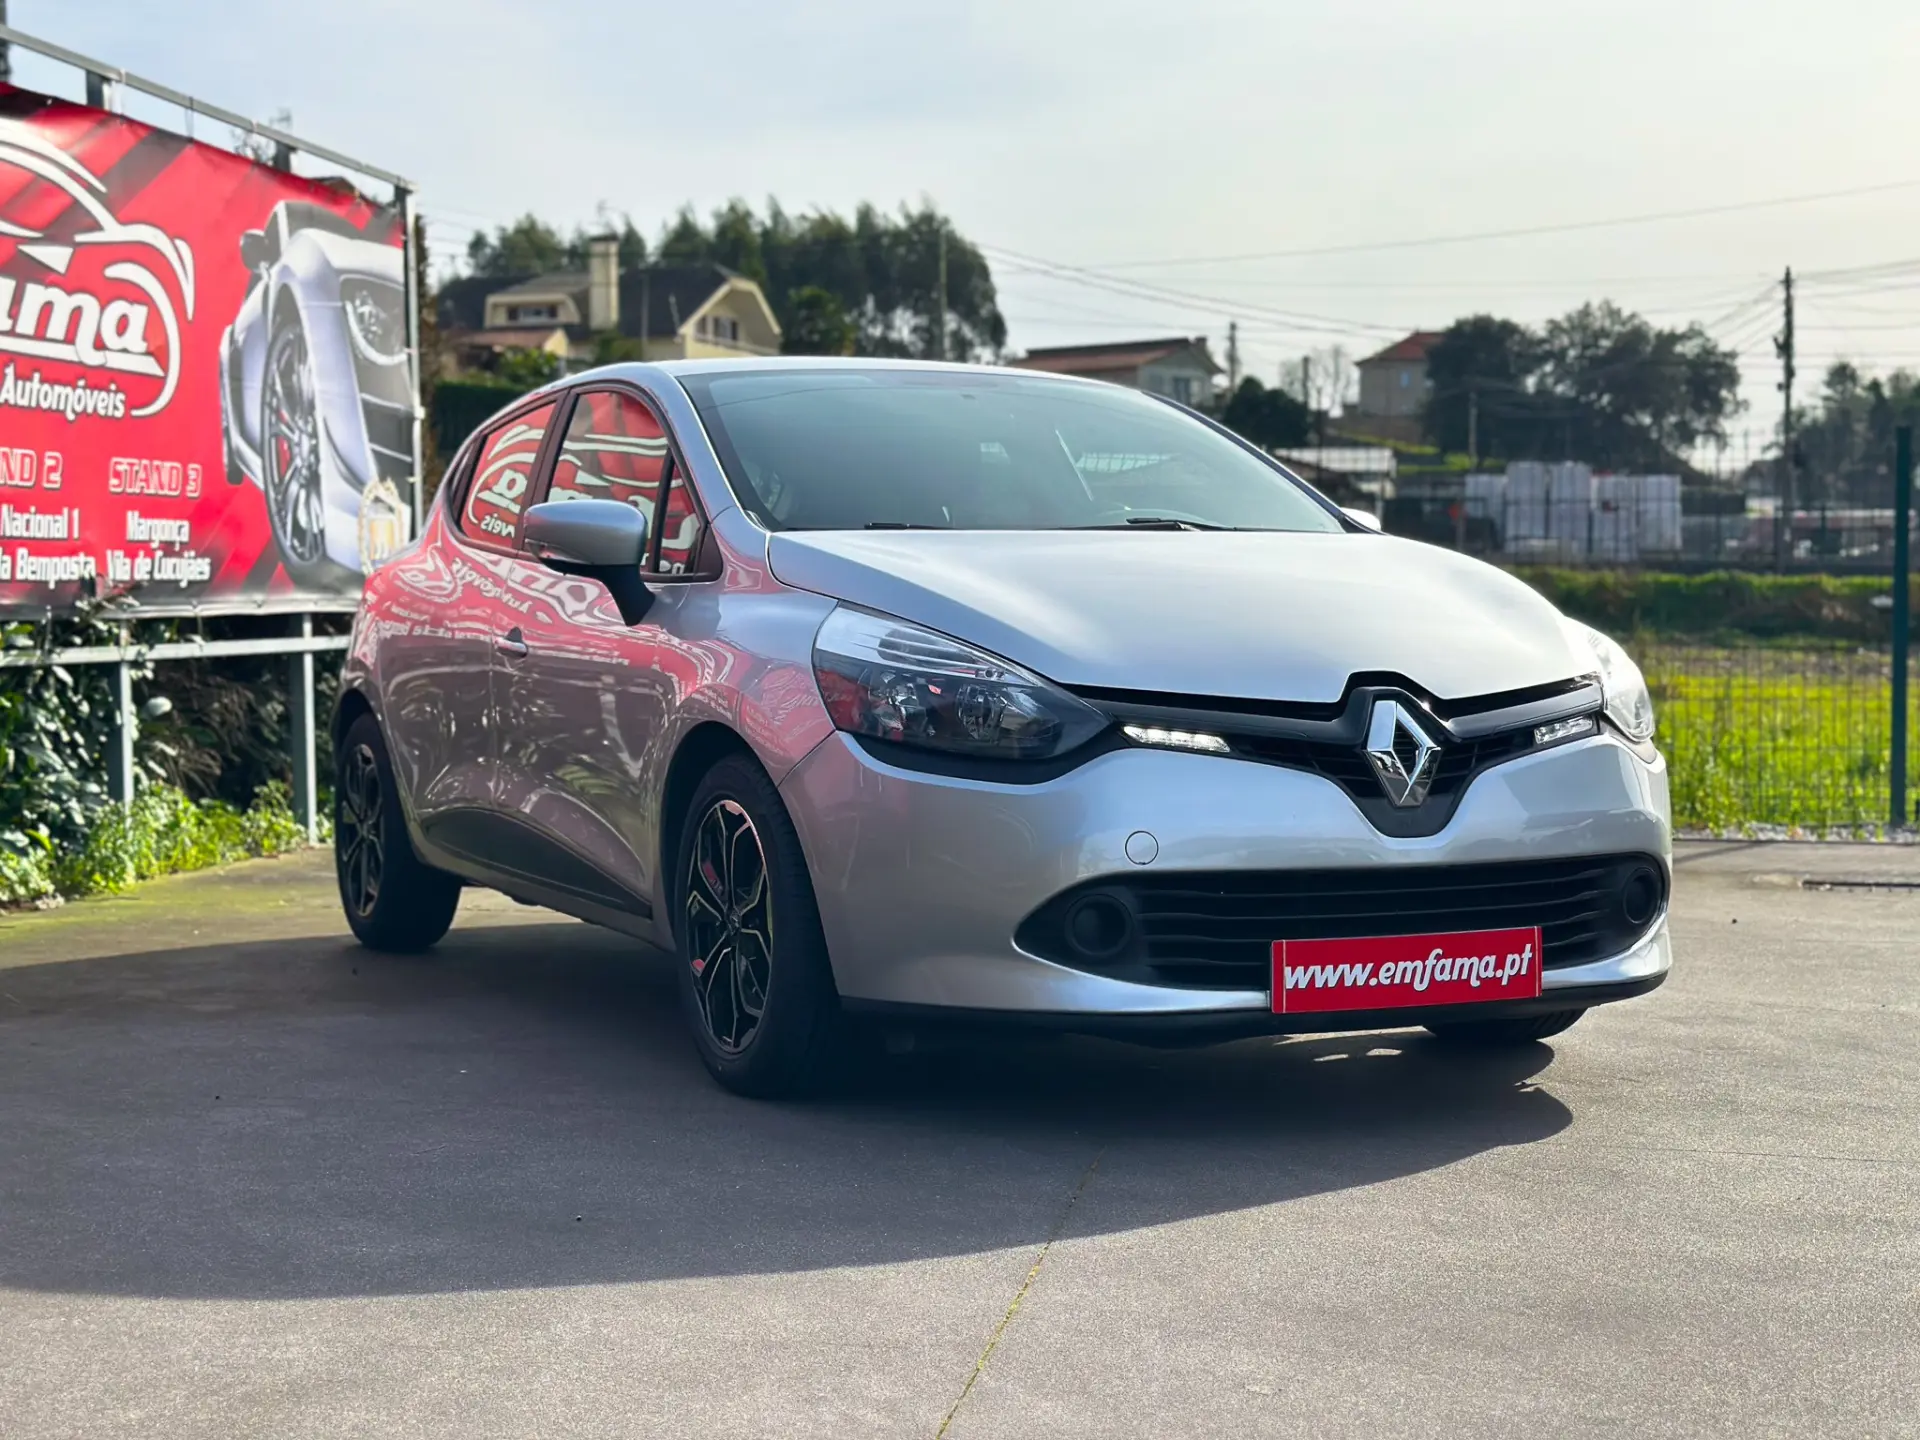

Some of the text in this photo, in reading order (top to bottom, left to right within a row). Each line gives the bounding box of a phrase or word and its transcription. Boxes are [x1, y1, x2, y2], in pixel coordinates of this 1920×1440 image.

[0, 362, 126, 421] Automóveis
[43, 451, 63, 490] 2
[109, 457, 202, 498] STAND 3
[0, 503, 69, 539] Nacional
[0, 546, 97, 590] a Bemposta
[133, 550, 152, 580] de
[1285, 943, 1533, 992] www.emfama.pt
